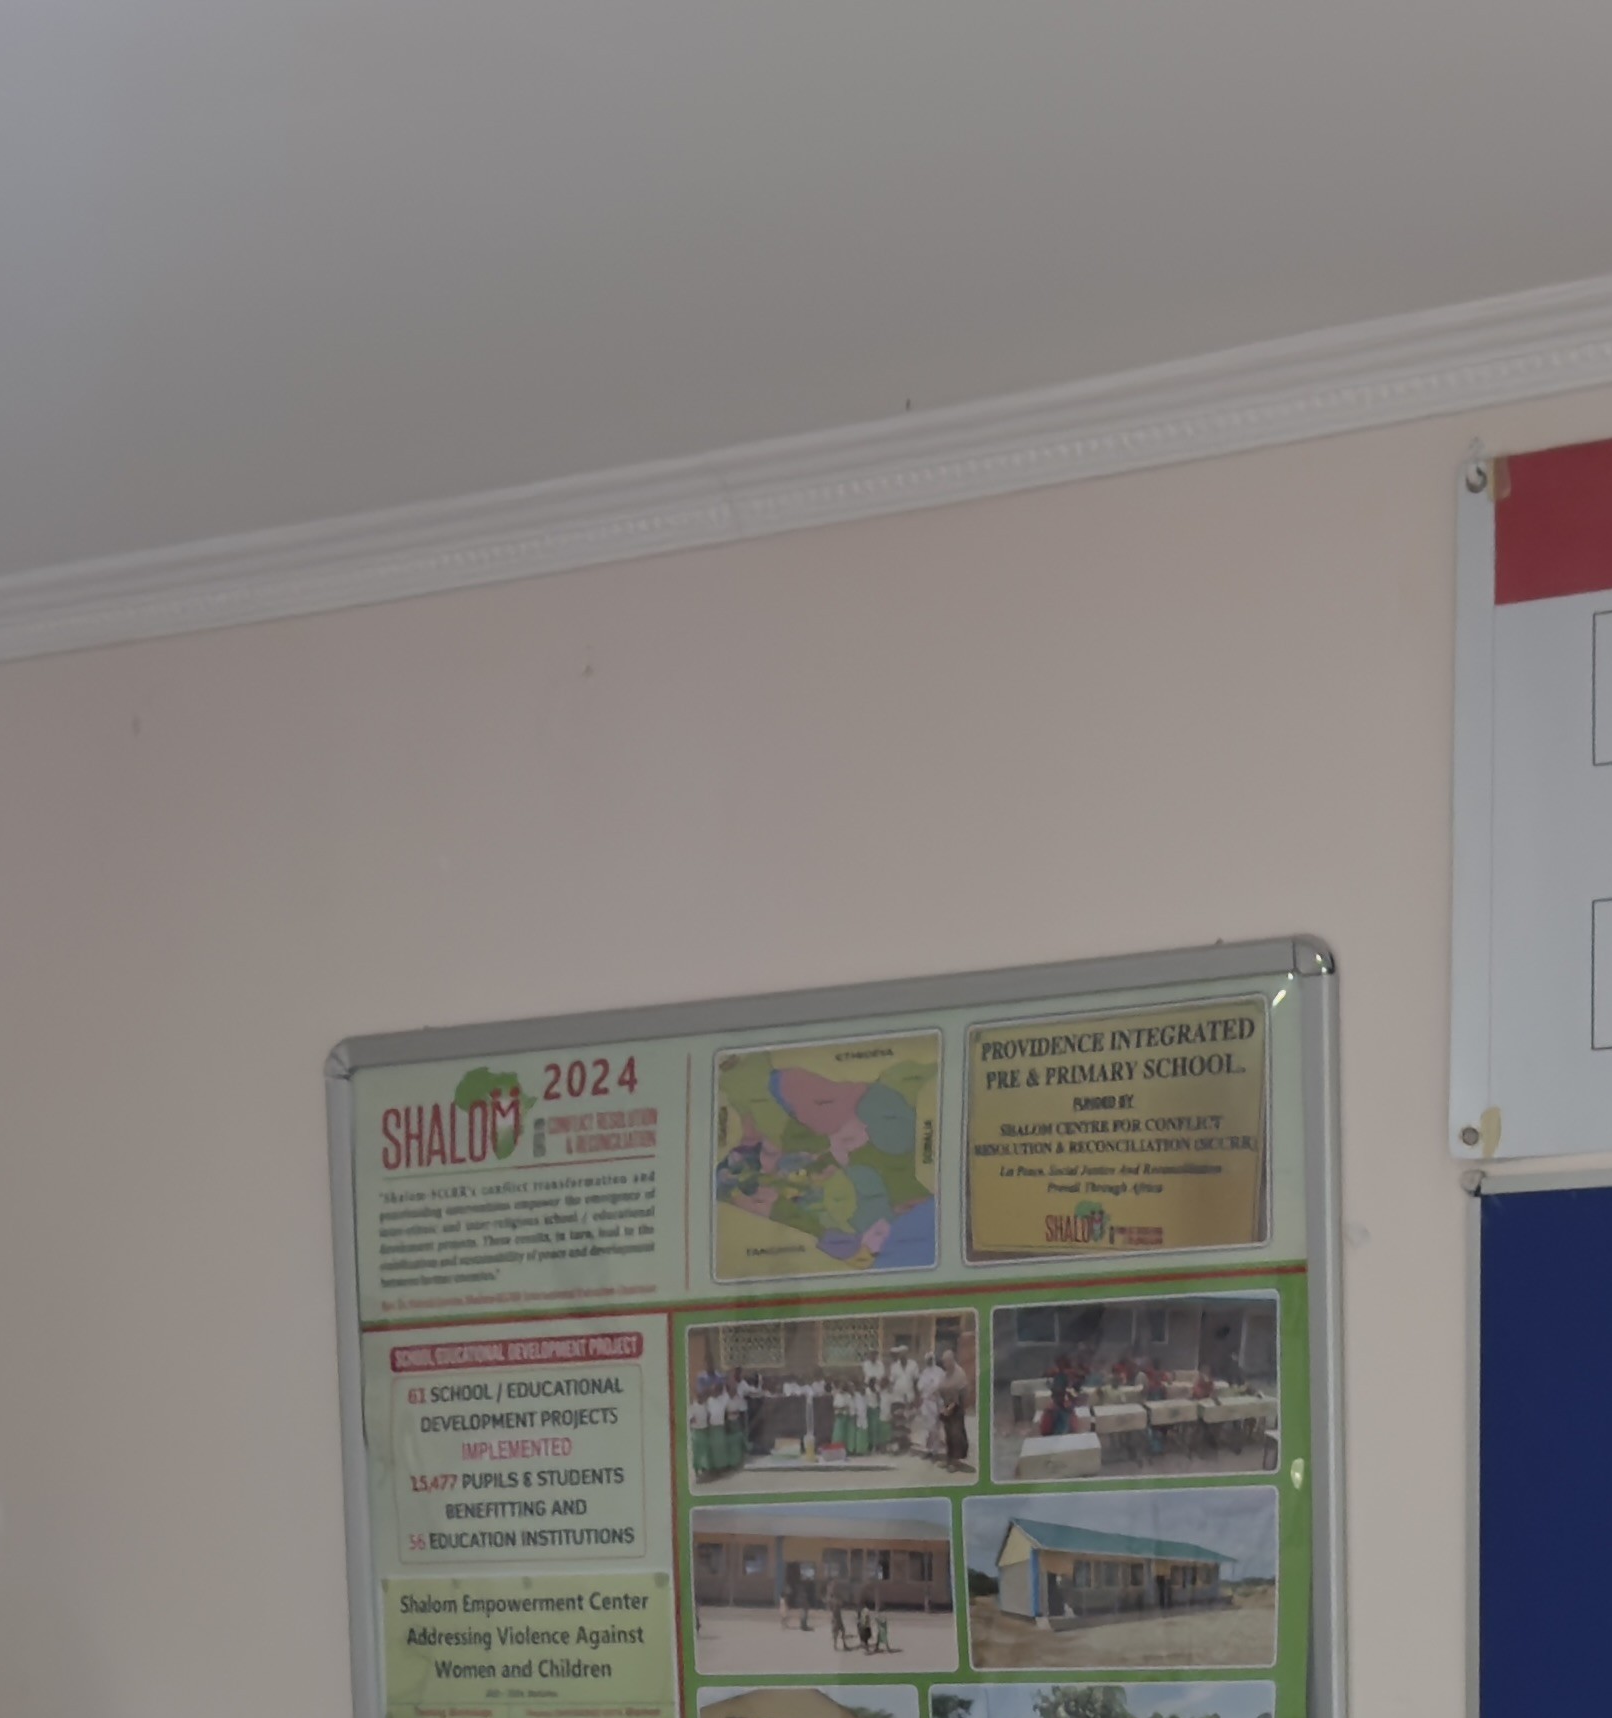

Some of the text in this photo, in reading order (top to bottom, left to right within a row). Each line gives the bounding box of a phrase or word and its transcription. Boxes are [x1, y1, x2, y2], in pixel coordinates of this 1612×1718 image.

[981, 1016, 1256, 1062] PROVIDENCE INTEGRATED
[543, 1055, 639, 1101] 2024
[985, 1068, 1022, 1091] PRE
[1026, 1066, 1040, 1088] &
[1045, 1060, 1139, 1087] PRIMARY
[382, 1088, 522, 1171] SHALOM
[1056, 1118, 1110, 1136] CENTRE
[1143, 1114, 1225, 1132] CONFLICT
[430, 1383, 494, 1404] SCHOOL
[506, 1377, 625, 1399] EDUCATIONAL
[420, 1407, 620, 1434] DEVELOPMENT PROJECTS
[461, 1436, 573, 1460] IMPLEMENTED
[461, 1470, 519, 1490] PUPILS
[536, 1466, 626, 1487] STUDENTS
[445, 1498, 588, 1521] BENEFITTING AND
[429, 1529, 517, 1550] EDUCATION
[521, 1526, 636, 1547] INSTITUTIONS
[400, 1591, 649, 1618] Shalom Empowerment Center
[406, 1624, 645, 1650] Addressing Violence Against
[435, 1658, 613, 1679] Women and Children
